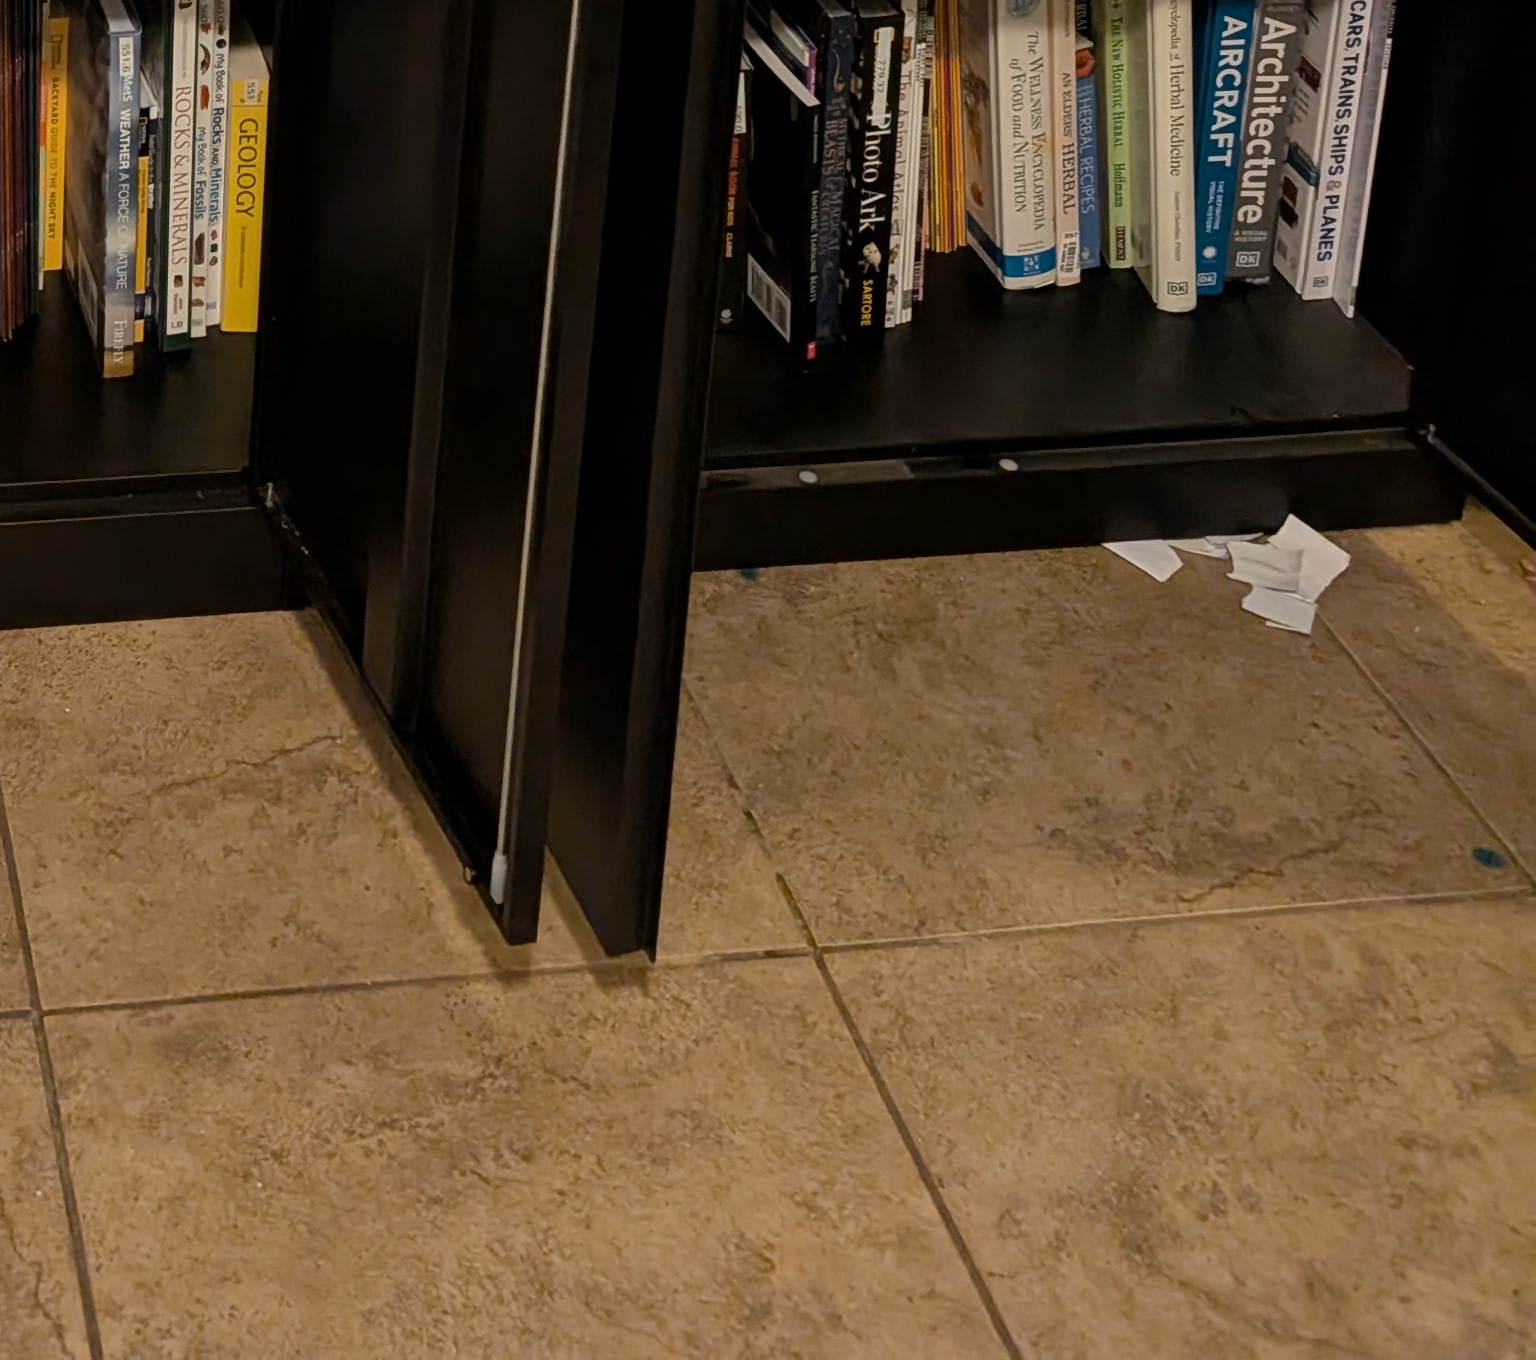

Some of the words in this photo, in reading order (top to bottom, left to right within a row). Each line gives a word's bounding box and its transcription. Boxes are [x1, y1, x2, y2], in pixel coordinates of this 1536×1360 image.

[1207, 15, 1243, 167] AIRCRAFT
[1237, 17, 1297, 224] Architecture
[234, 118, 257, 218] GEOLOGY
